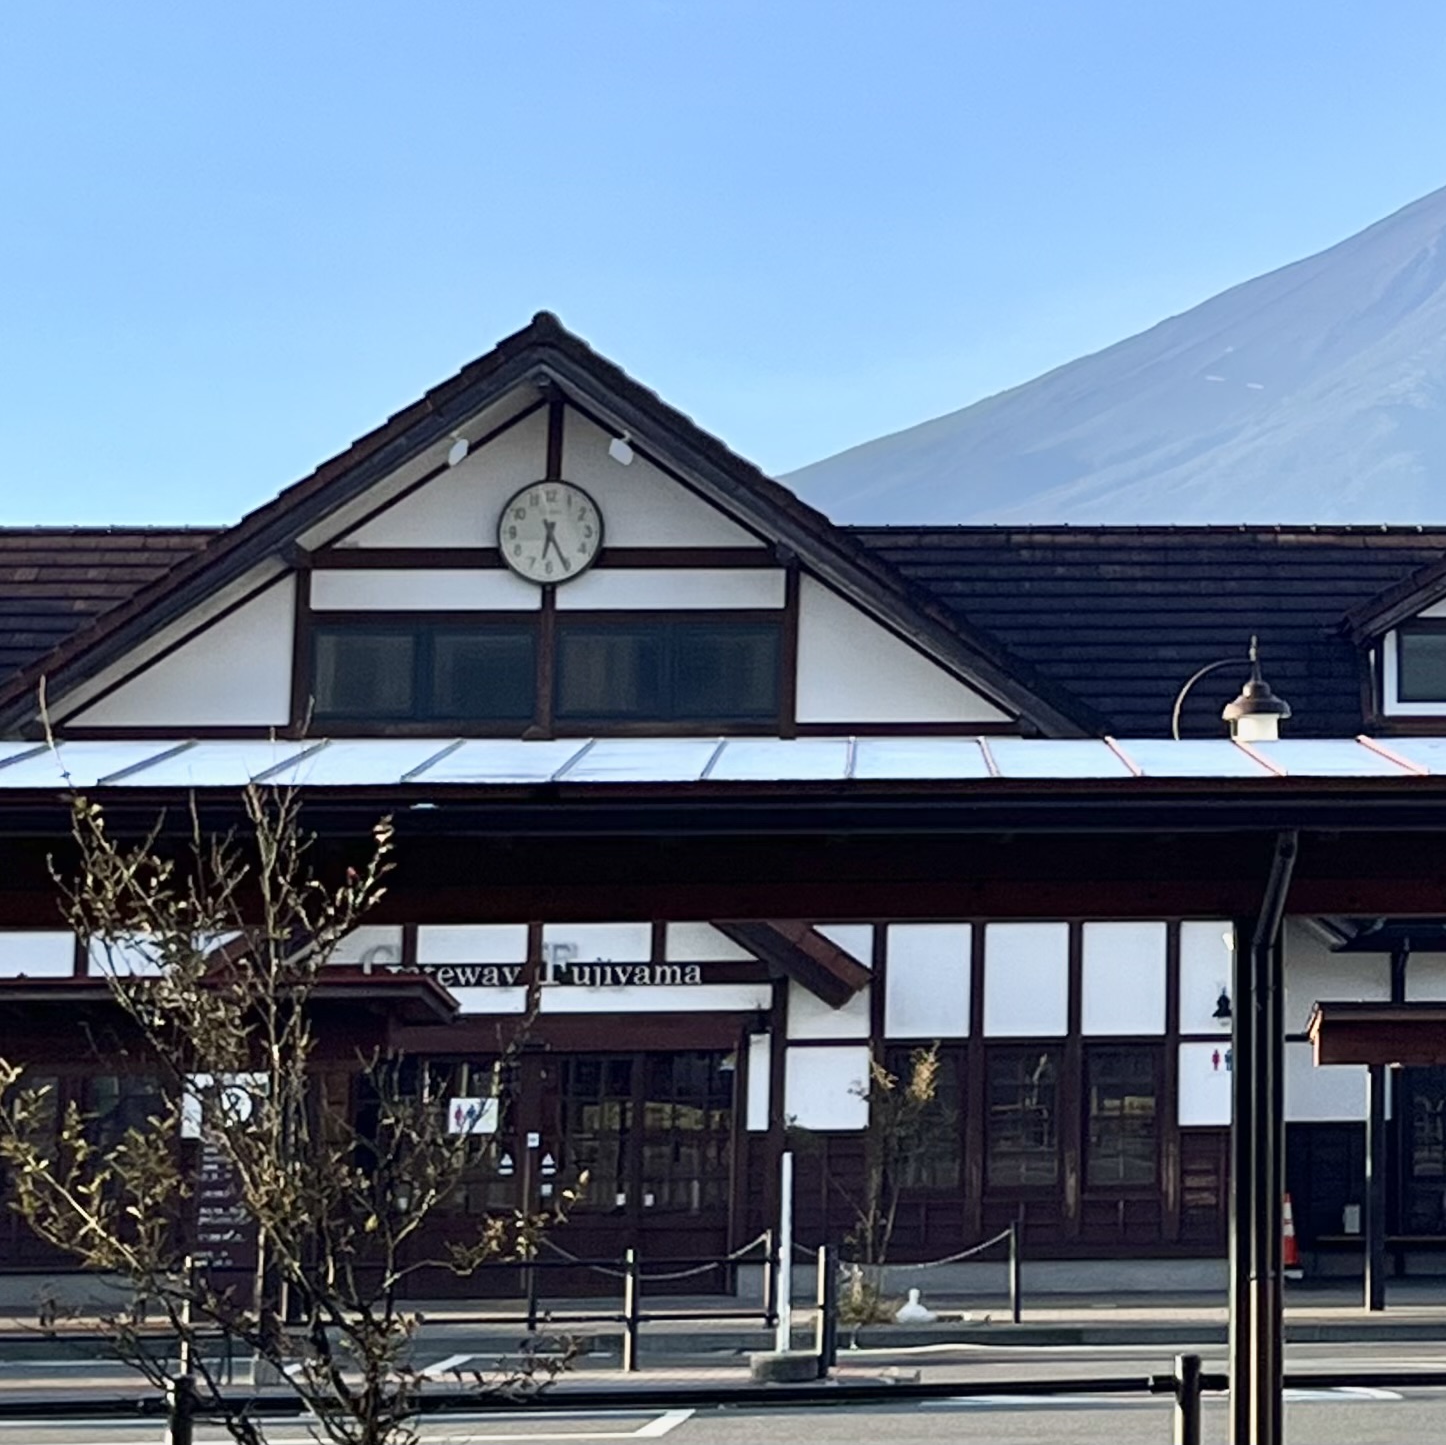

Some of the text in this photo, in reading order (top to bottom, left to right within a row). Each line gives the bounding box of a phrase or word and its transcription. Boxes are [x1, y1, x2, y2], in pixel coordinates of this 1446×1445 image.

[529, 492, 539, 506] 11
[546, 490, 557, 502] 12
[513, 507, 526, 521] 10
[577, 506, 587, 522] 2
[509, 525, 517, 539] 9
[584, 525, 593, 538] 3
[514, 544, 522, 556] 8
[576, 542, 587, 555] 4
[526, 556, 536, 569] 7
[545, 561, 553, 574] 6
[538, 942, 702, 991] Fujiyama
